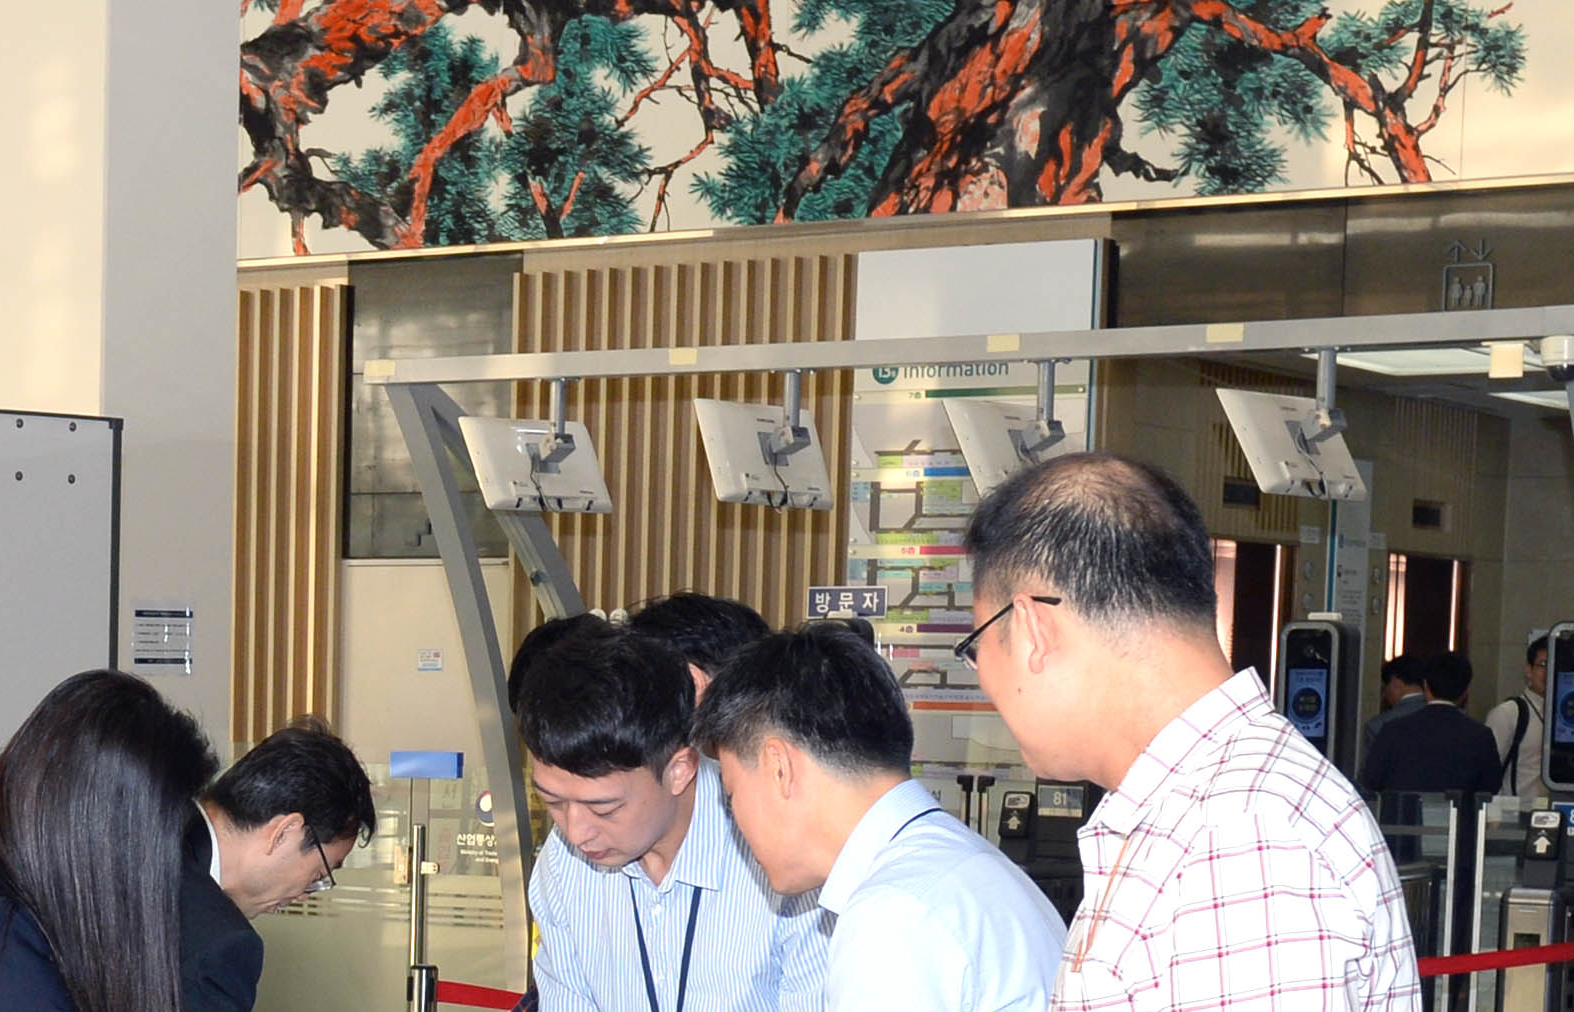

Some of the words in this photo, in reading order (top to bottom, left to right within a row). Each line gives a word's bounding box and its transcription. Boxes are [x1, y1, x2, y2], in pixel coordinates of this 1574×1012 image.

[815, 592, 879, 614] 방문자
[1053, 791, 1067, 806] 81
[457, 832, 497, 847] 산업통상
